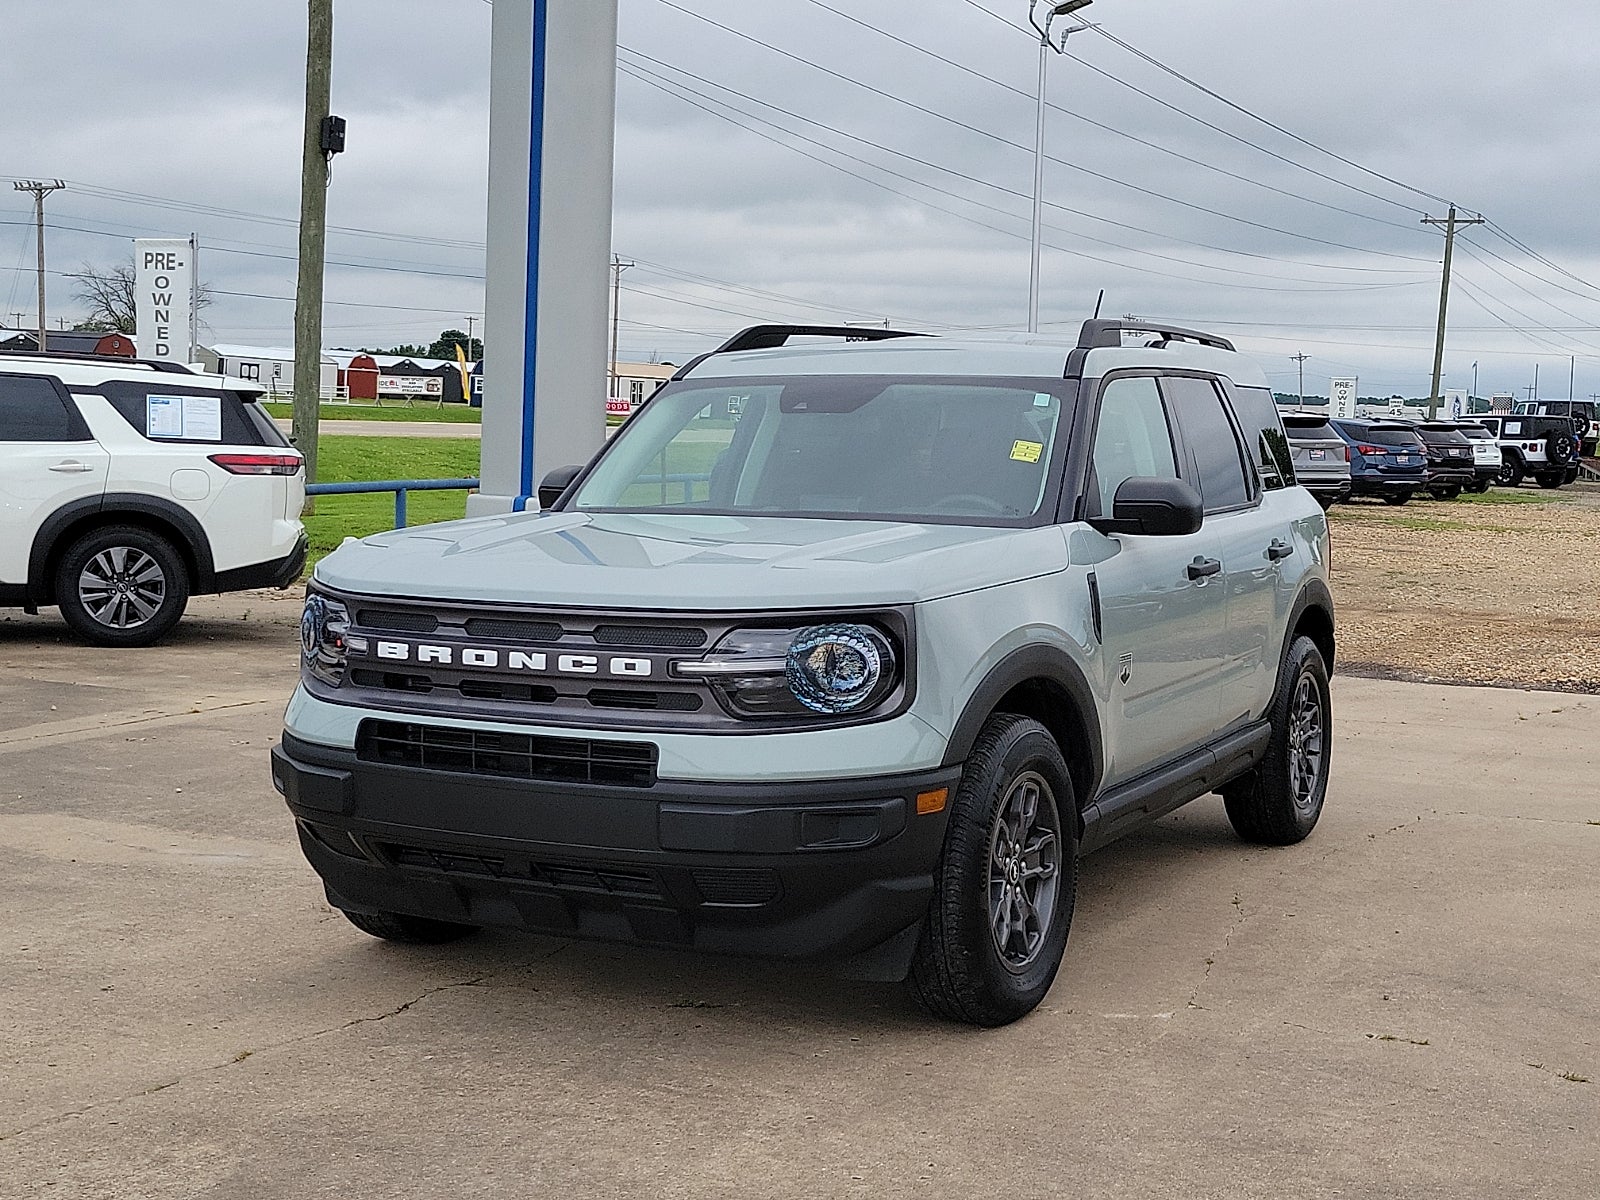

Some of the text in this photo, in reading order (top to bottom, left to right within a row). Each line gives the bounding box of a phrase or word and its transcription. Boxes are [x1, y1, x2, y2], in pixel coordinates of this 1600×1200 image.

[144, 252, 184, 271] PRE-
[152, 275, 172, 357] OWNED
[1334, 381, 1353, 389] PRE-
[1337, 389, 1347, 418] OWNED
[1389, 408, 1402, 416] 45
[377, 641, 651, 676] BRONCO
